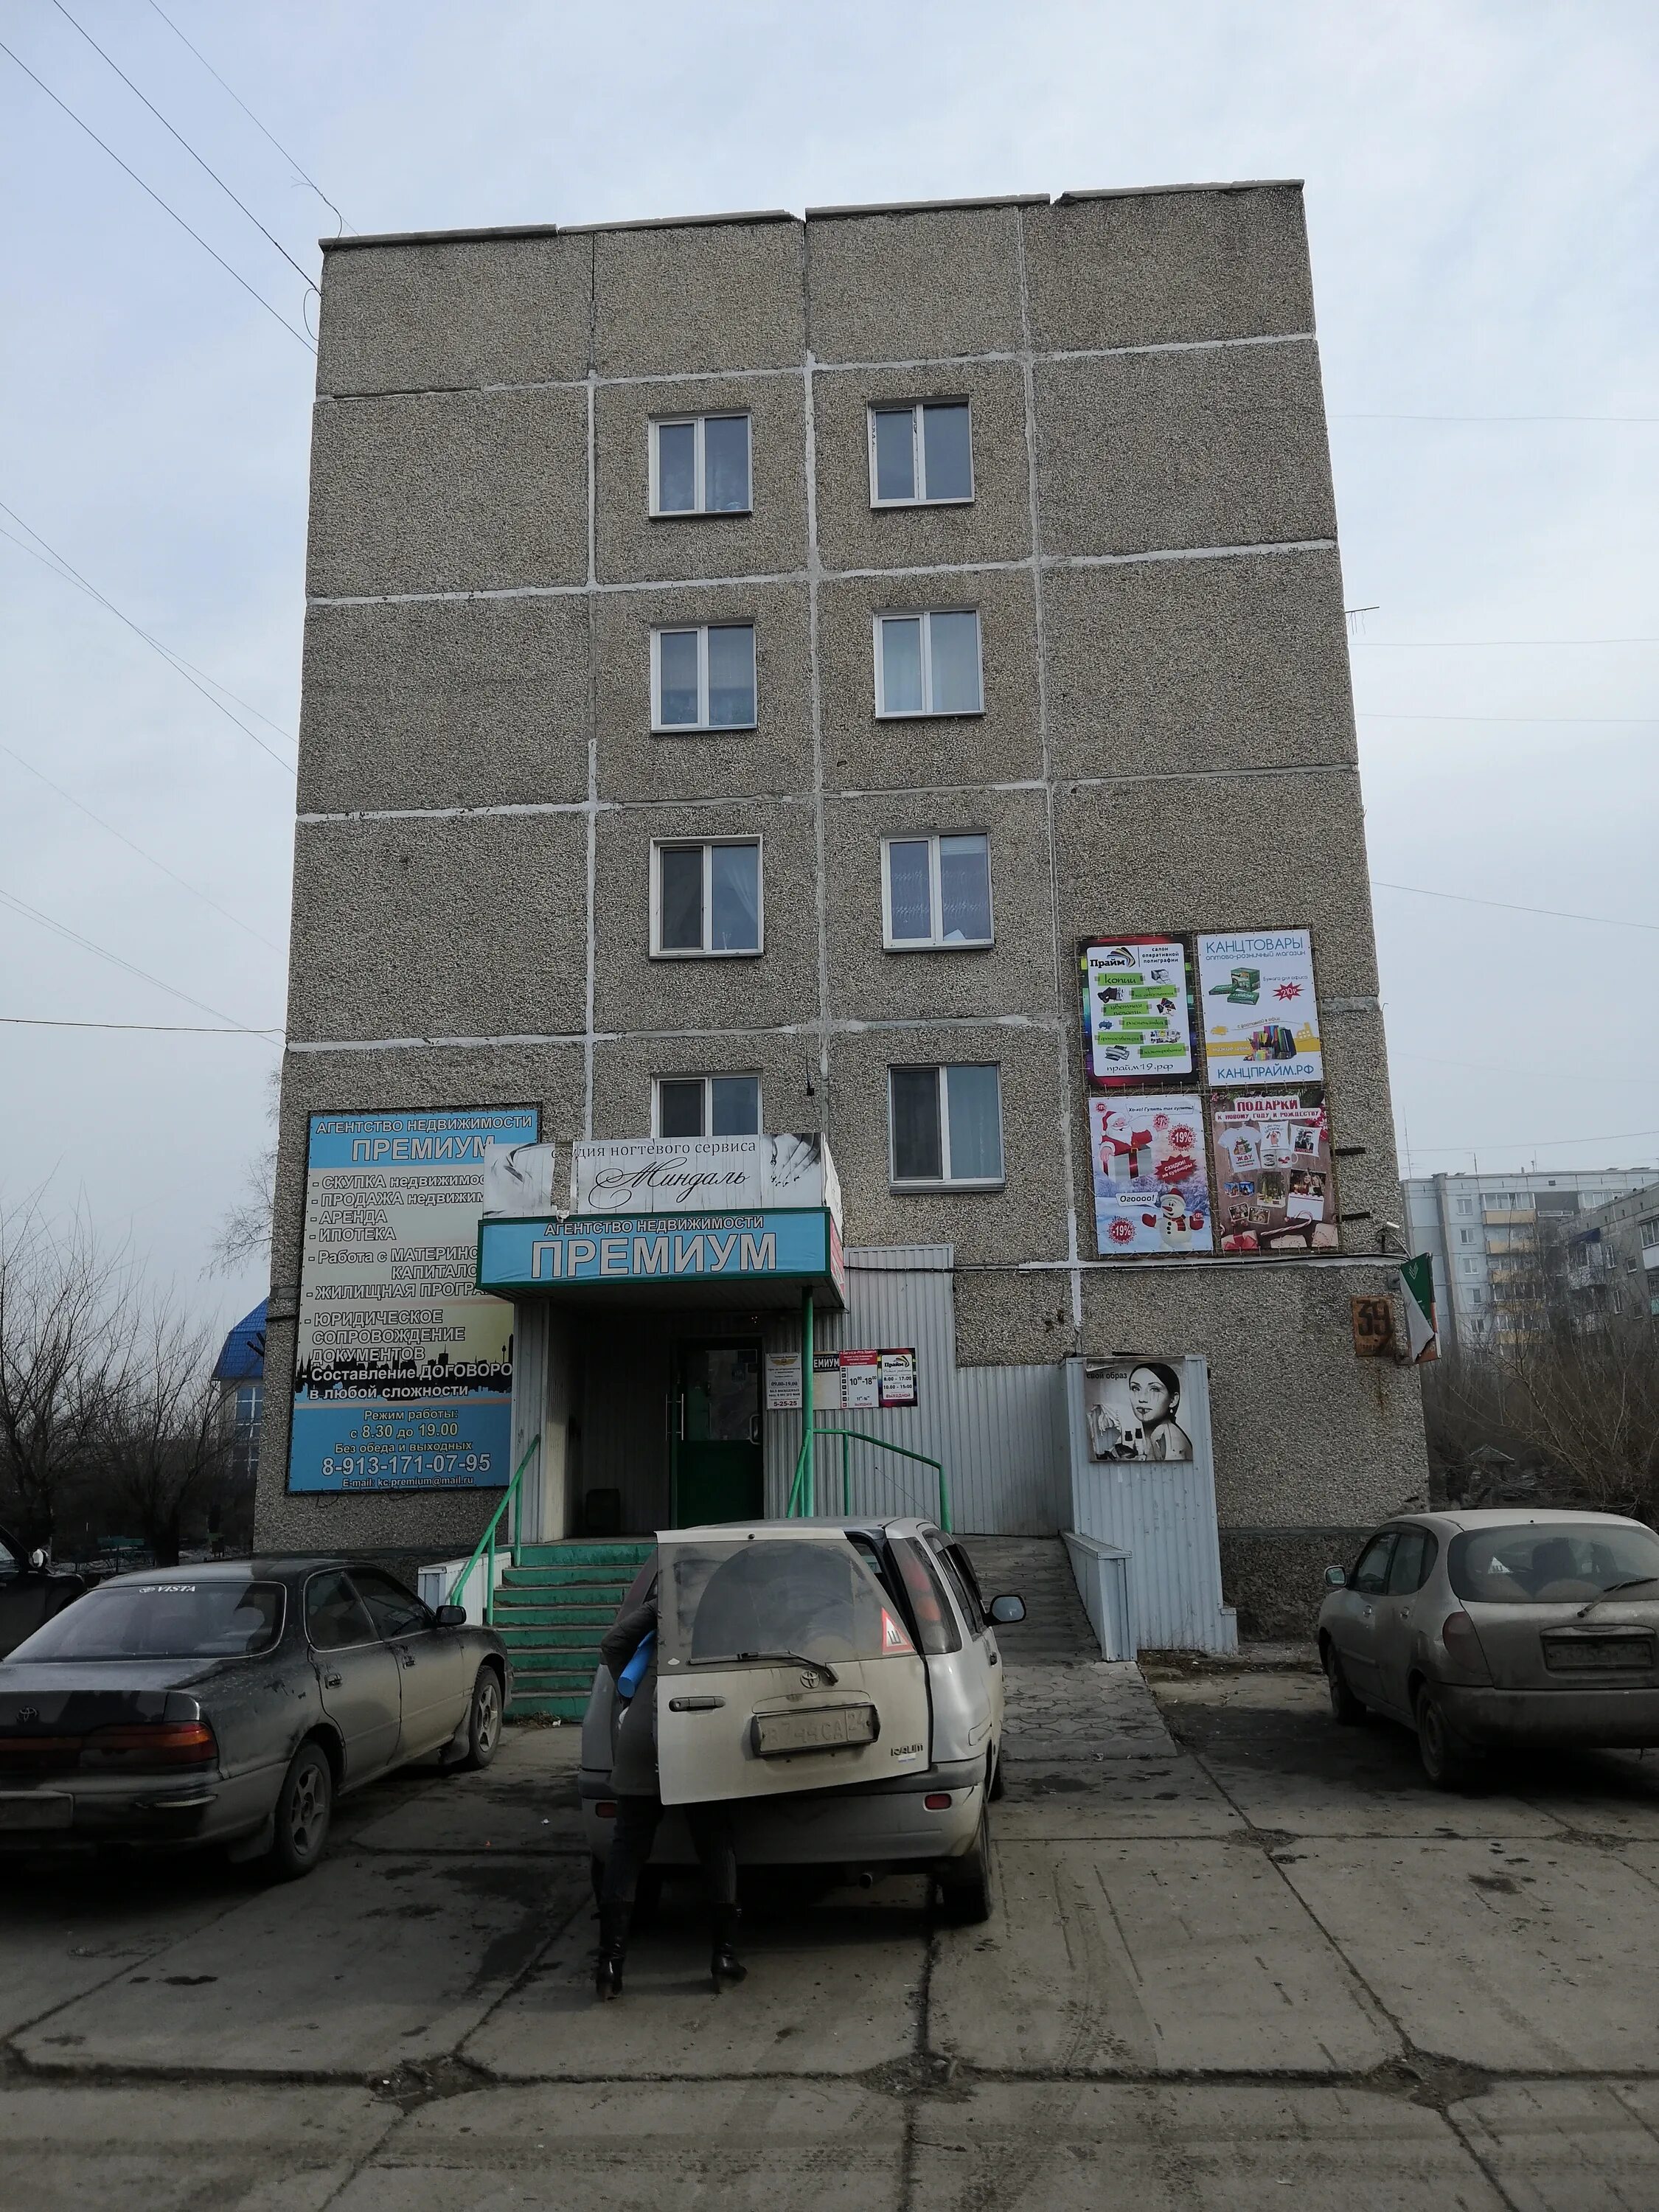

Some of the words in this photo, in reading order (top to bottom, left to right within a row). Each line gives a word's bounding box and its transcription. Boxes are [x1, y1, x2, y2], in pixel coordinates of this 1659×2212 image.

[1206, 937, 1304, 953] КАНЦТОВАРЫ
[1090, 958, 1125, 968] Прайм
[1206, 950, 1274, 961] оптово-розничный
[1107, 1062, 1174, 1074] прайм19.рф
[1217, 1063, 1315, 1079] КАНЦПРАЙМ.РФ
[1237, 1099, 1298, 1112] ПОДАРКИ
[316, 1120, 403, 1134] АГЕНТСТВО
[406, 1116, 532, 1133] НЕДВИЖИМОСТИ
[1172, 1131, 1193, 1143] -19%
[352, 1135, 495, 1162] ПРЕМИУМ
[551, 1147, 605, 1160] сдия
[610, 1144, 690, 1157] ногтевого
[695, 1141, 756, 1155] сервиса
[1237, 1154, 1253, 1162] ЖДУ
[1164, 1160, 1186, 1172] СКИДКИ!
[1169, 1163, 1194, 1177] сувениры
[321, 1175, 386, 1189] СКУПКА
[588, 1157, 751, 1209] Миндаль
[321, 1192, 403, 1208] ПРОДАЖА
[1119, 1194, 1155, 1203] Огоооо!
[319, 1209, 388, 1226] АРЕНДА
[544, 1221, 633, 1236] АГЕНТСТВО
[636, 1216, 765, 1234] НЕДВИЖИМОСТИ
[1112, 1225, 1132, 1238] -19%
[319, 1227, 397, 1242] ИПОТЕКА
[318, 1250, 374, 1264] Работа
[377, 1251, 387, 1262] с
[531, 1232, 777, 1279] ПРЕМИУМ
[391, 1263, 477, 1280] КАПИТАЛО
[316, 1284, 416, 1301] ЖИЛИЩНАЯ
[419, 1281, 488, 1298] ПРОГРА
[313, 1310, 443, 1327] ЮРИДИЧЕСКОЕ
[312, 1327, 466, 1344] СОПРОВОЖДЕНИЕ
[310, 1346, 425, 1366] ДОКУМЕНТОВ
[310, 1366, 419, 1382] Составление
[1106, 1371, 1127, 1380] образ
[309, 1389, 319, 1400] в
[322, 1385, 378, 1399] любой
[381, 1385, 469, 1399] сложности
[364, 1409, 405, 1422] Режим
[408, 1408, 459, 1422] работы:
[349, 1428, 358, 1439] с
[361, 1425, 394, 1439] 8.30
[396, 1428, 414, 1440] до
[418, 1422, 459, 1437] 19.00
[334, 1443, 356, 1454] Без
[359, 1442, 395, 1454] обеда
[398, 1444, 406, 1453] и
[409, 1441, 473, 1453] выходных
[321, 1453, 491, 1476] 8-913-171-07-95
[342, 1478, 375, 1488] E-mail:
[377, 1475, 474, 1487] kc.premium@mail.ru
[887, 1630, 901, 1644] Ш
